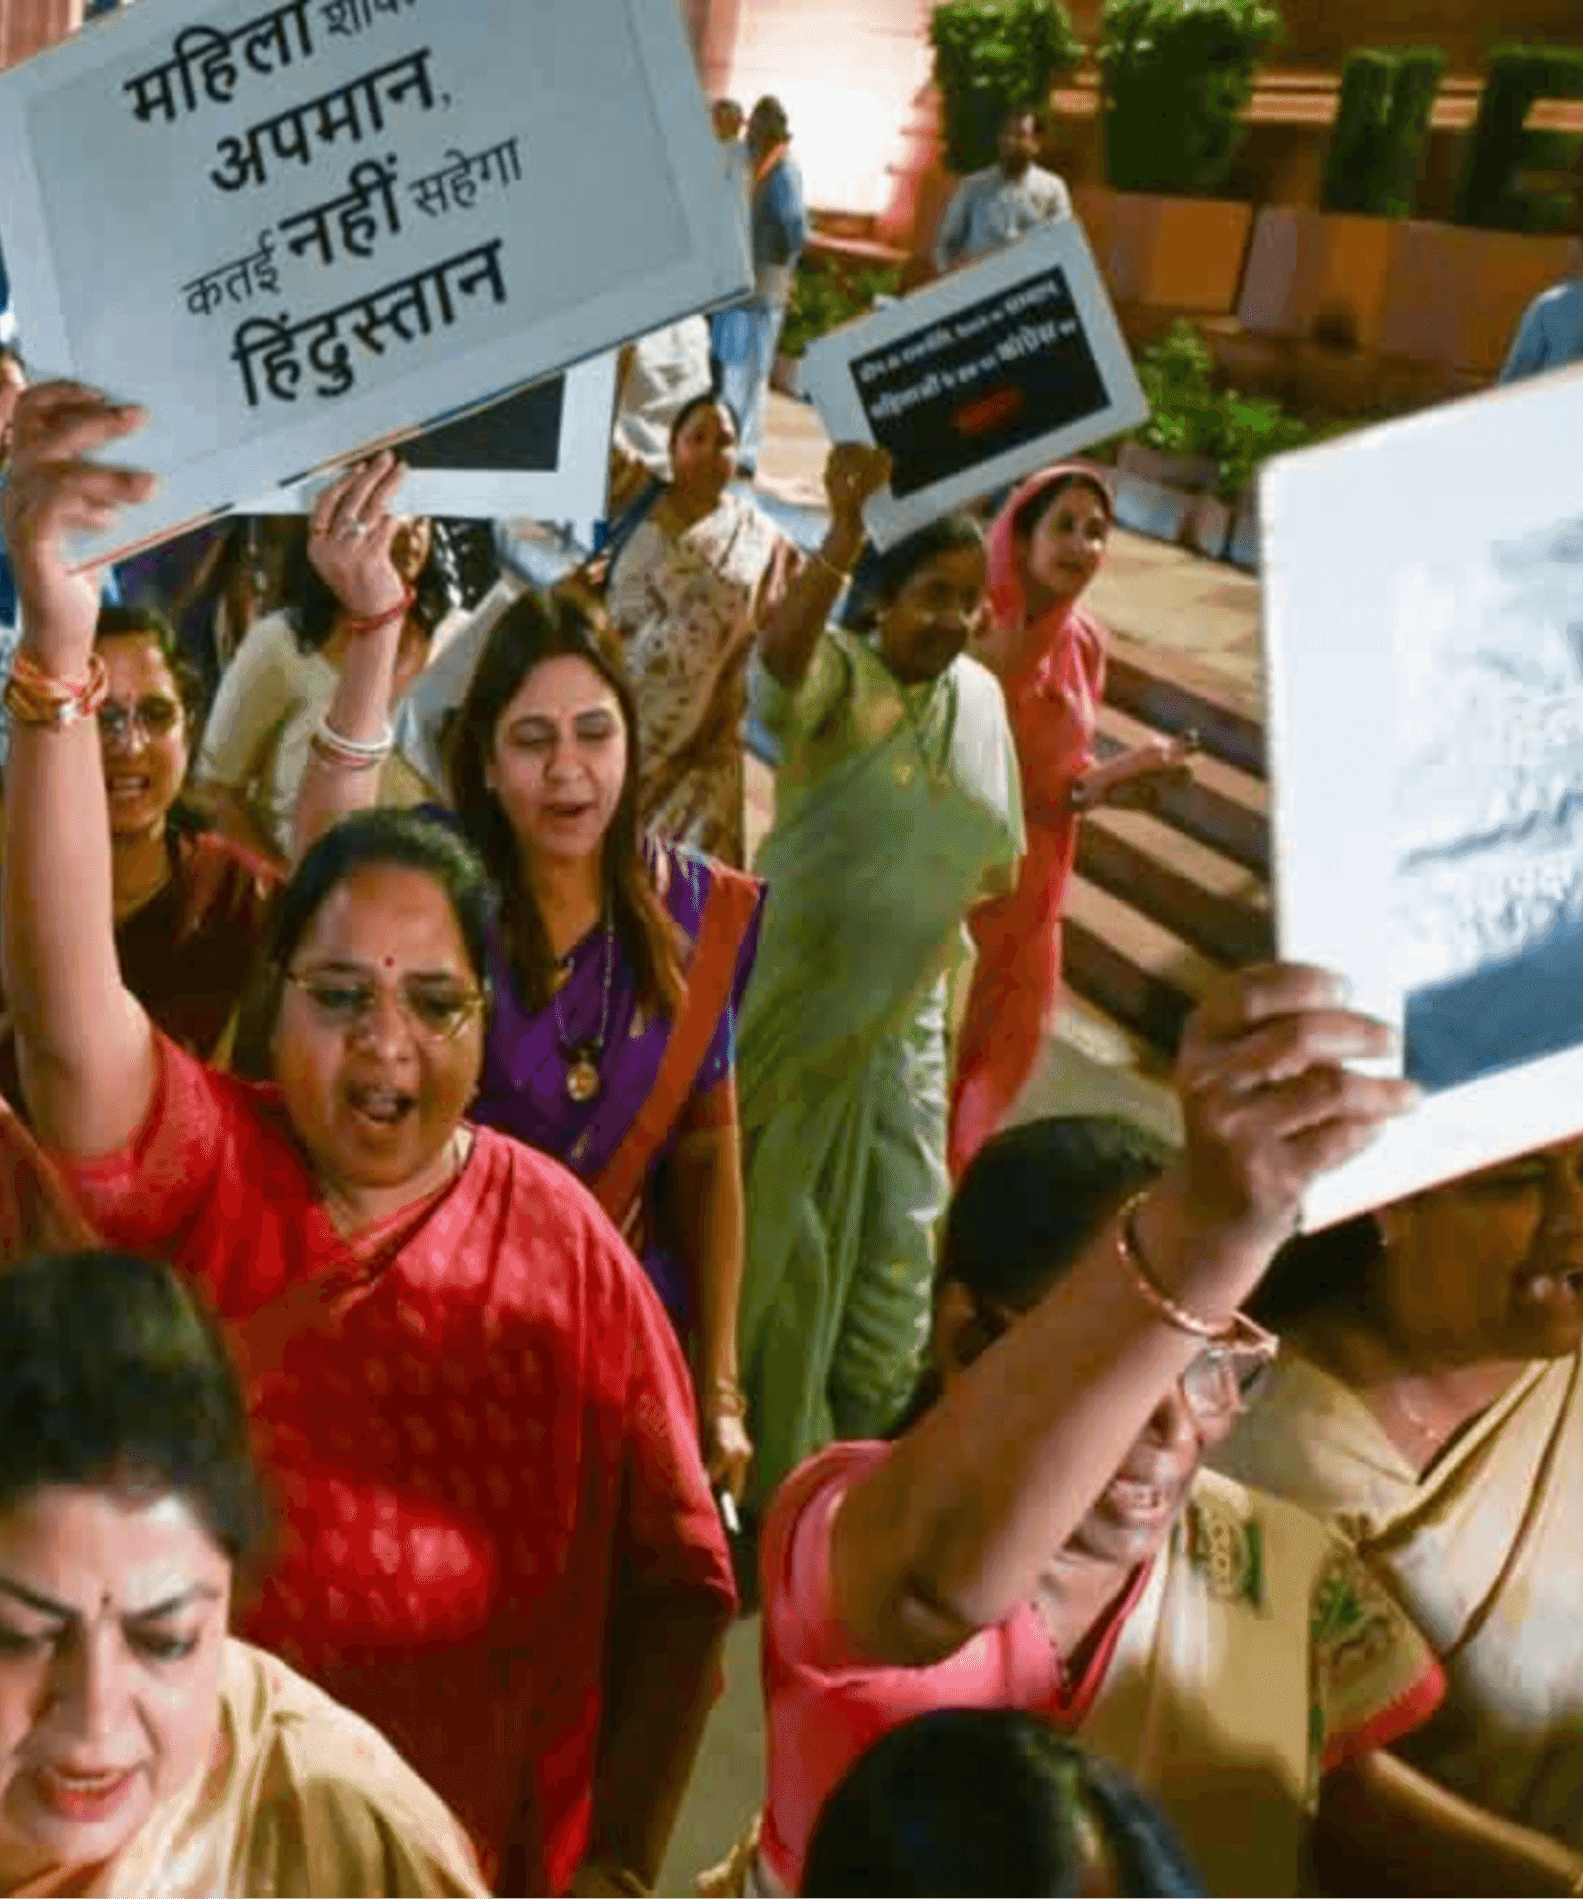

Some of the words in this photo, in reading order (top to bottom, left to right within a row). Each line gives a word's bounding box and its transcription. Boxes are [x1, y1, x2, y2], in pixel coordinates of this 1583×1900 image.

[123, 0, 313, 121] महिला
[211, 46, 451, 191] अपमान,
[180, 229, 282, 316] कतई
[277, 153, 401, 265] नहीं
[407, 137, 523, 218] सहेगा
[231, 238, 507, 407] हिंदुस्तान
